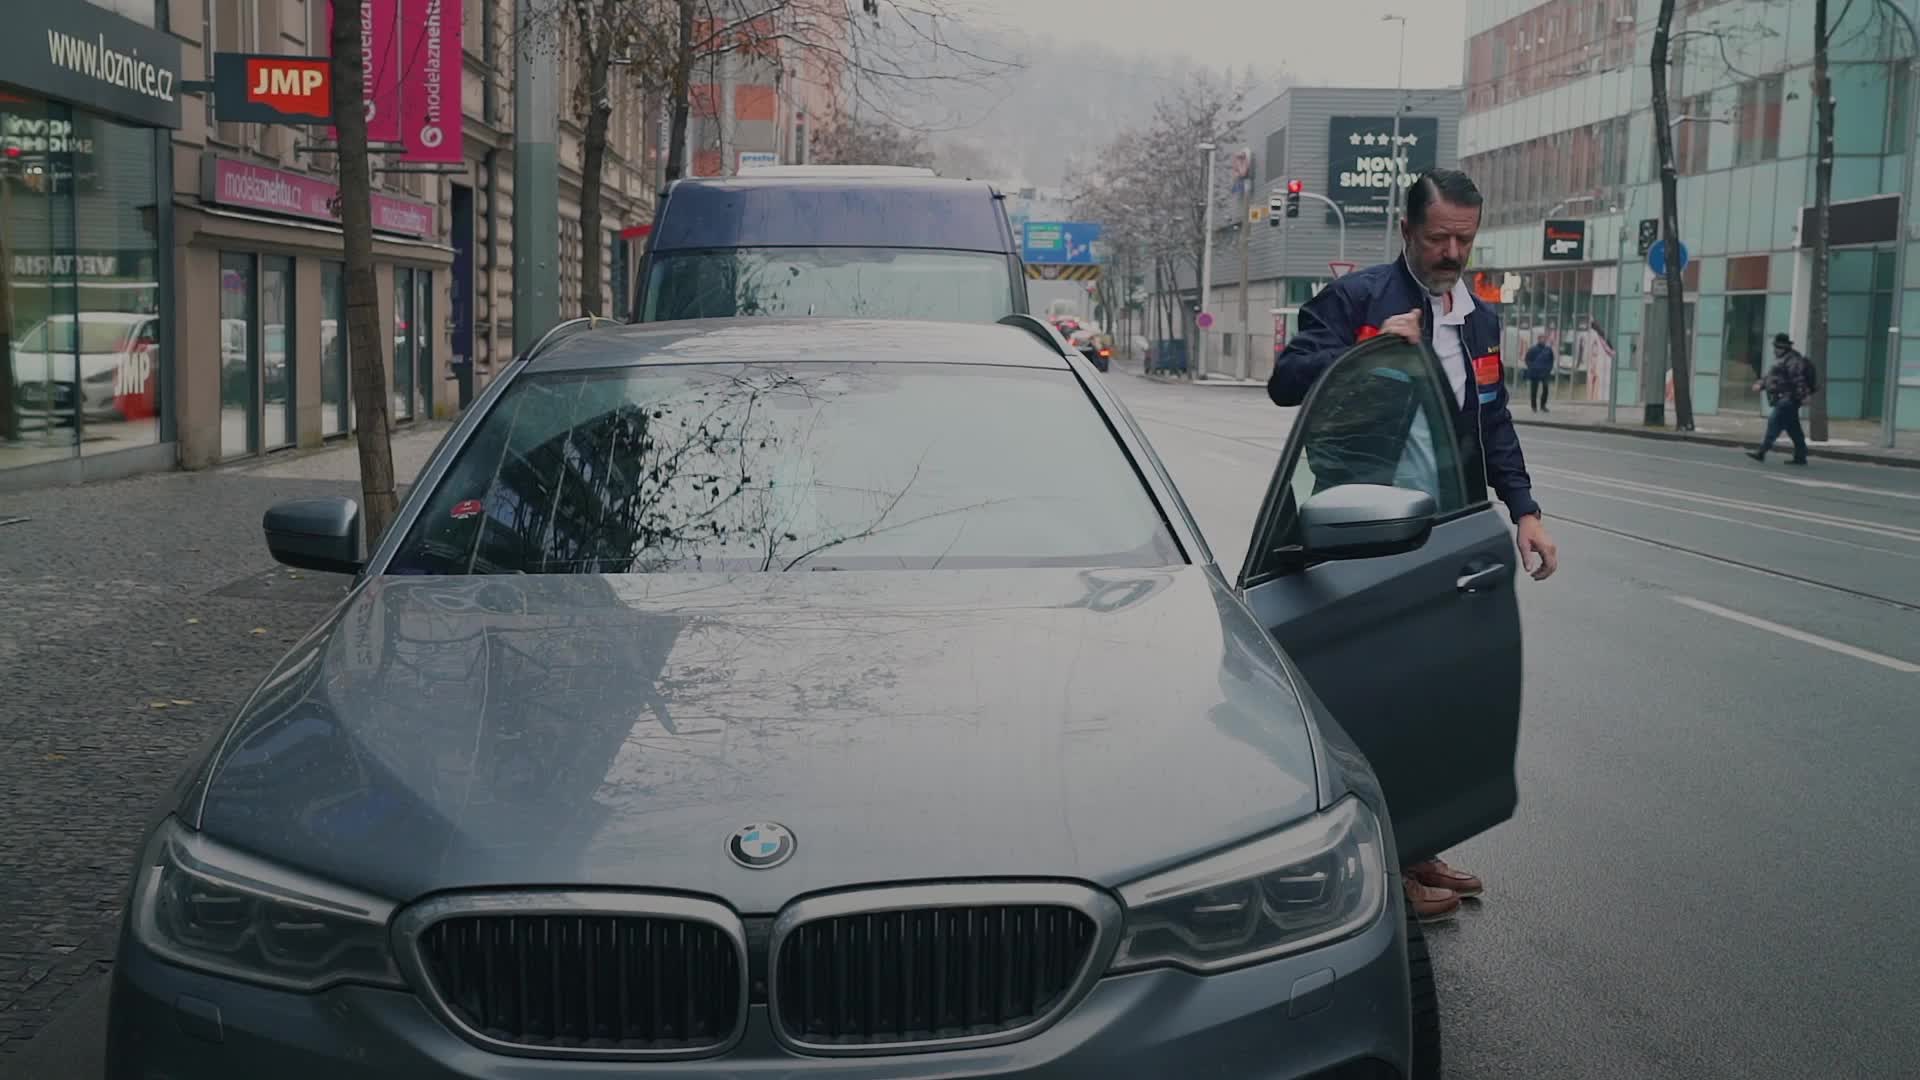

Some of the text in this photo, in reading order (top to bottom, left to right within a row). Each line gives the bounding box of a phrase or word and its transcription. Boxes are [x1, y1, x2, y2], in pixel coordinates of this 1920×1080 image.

[48, 29, 173, 102] www.loznice.cz
[253, 68, 323, 96] JMP
[112, 352, 150, 396] JMP
